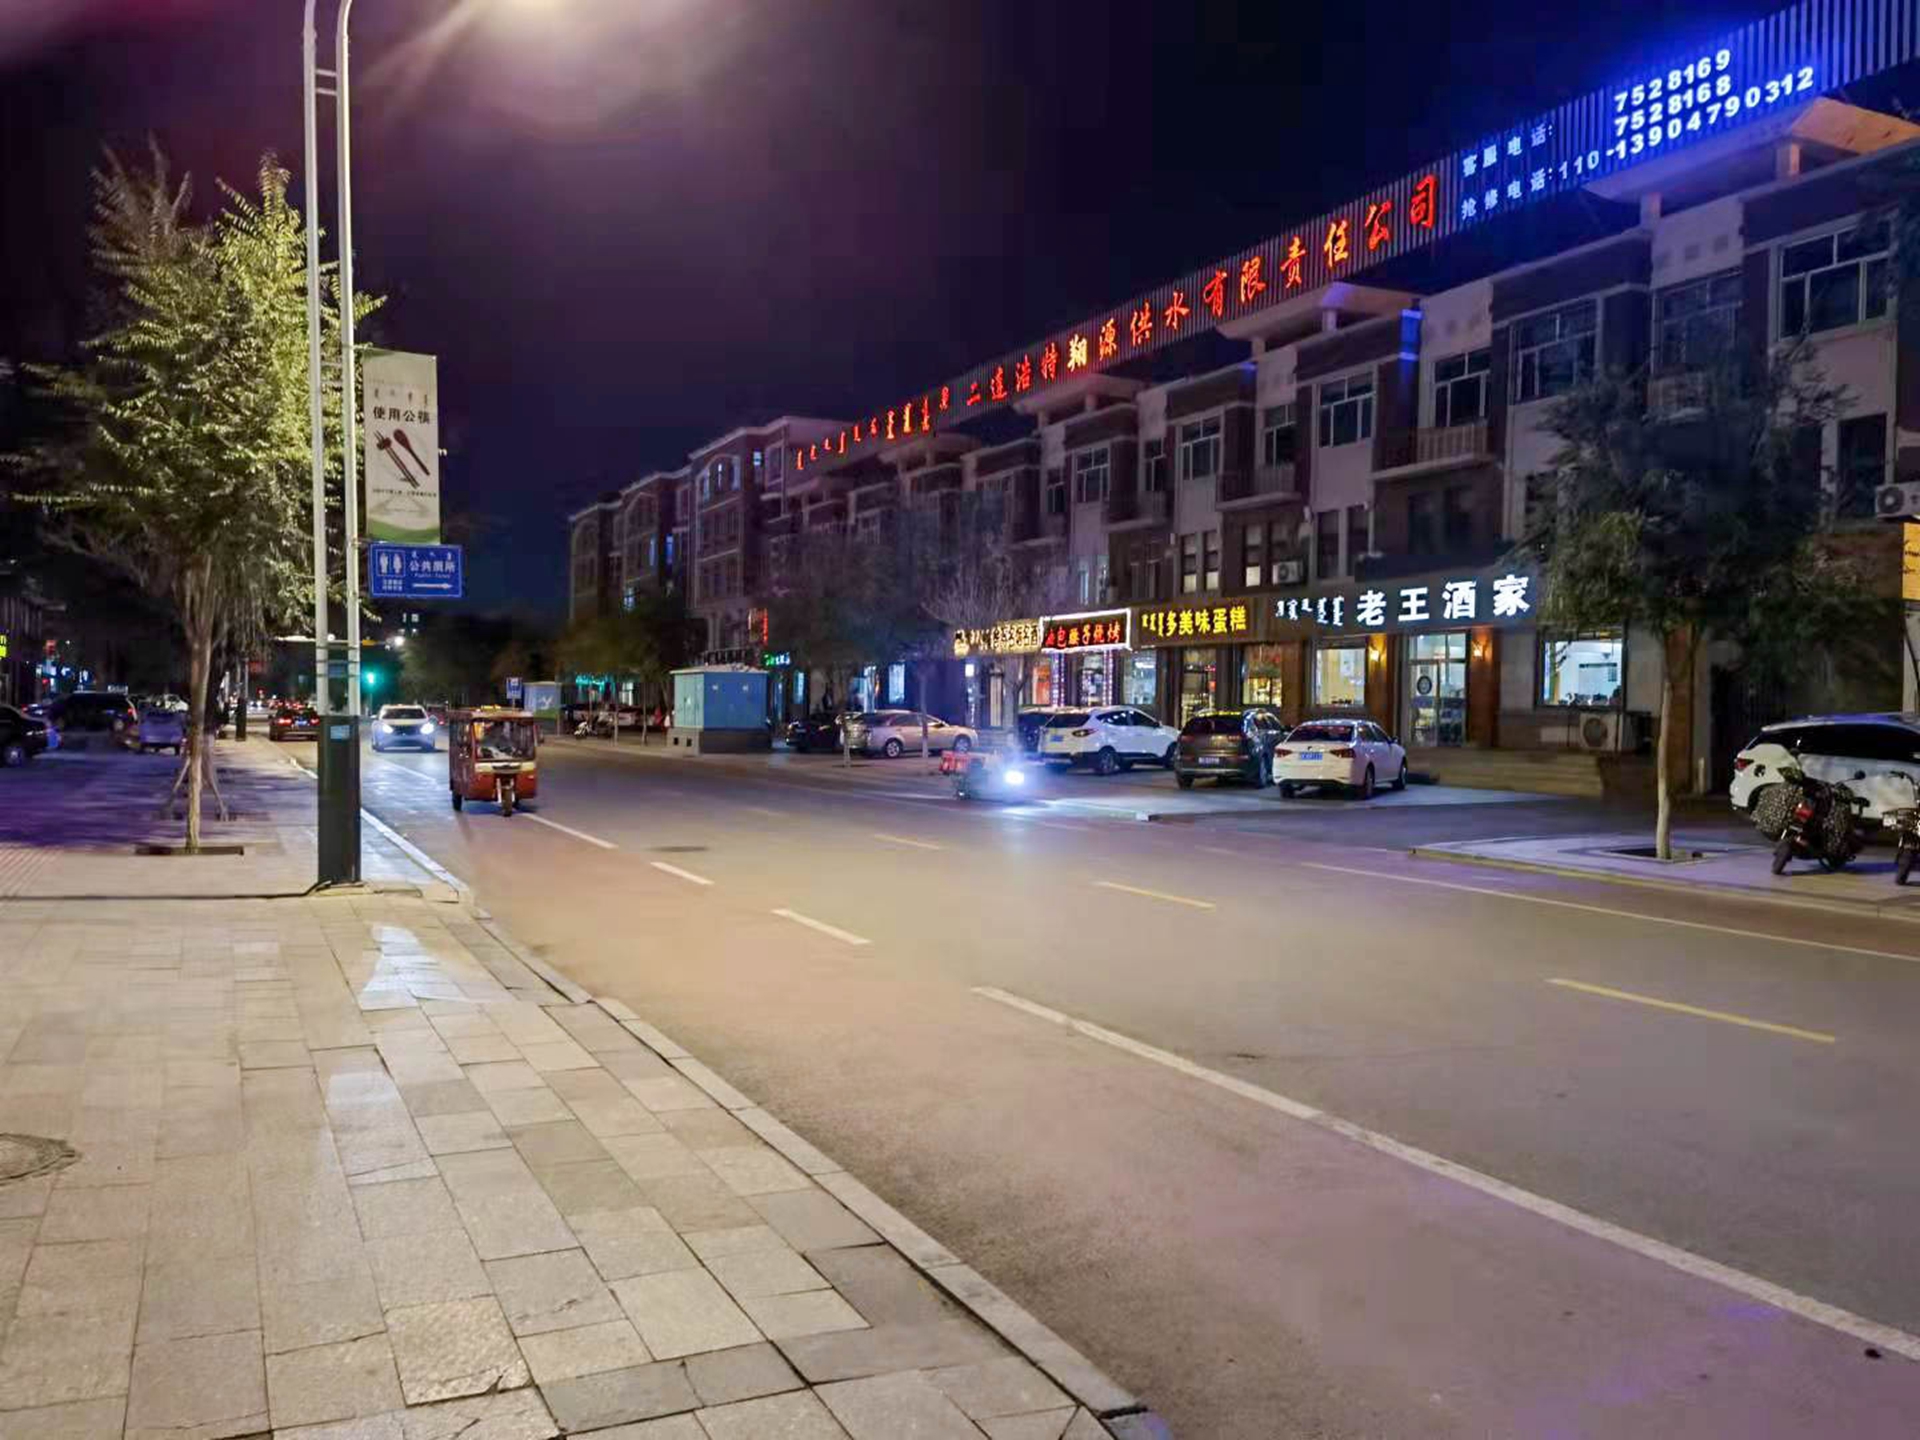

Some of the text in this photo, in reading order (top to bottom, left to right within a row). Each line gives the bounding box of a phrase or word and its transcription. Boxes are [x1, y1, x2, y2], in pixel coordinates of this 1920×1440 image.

[1614, 49, 1731, 113] 7528169
[1614, 75, 1732, 137] 7528168
[372, 405, 431, 425] 使用公筷
[408, 560, 456, 573] 公共厕所
[1166, 605, 1248, 638] 多美味蛋糕
[1356, 574, 1531, 627] 老王酒家
